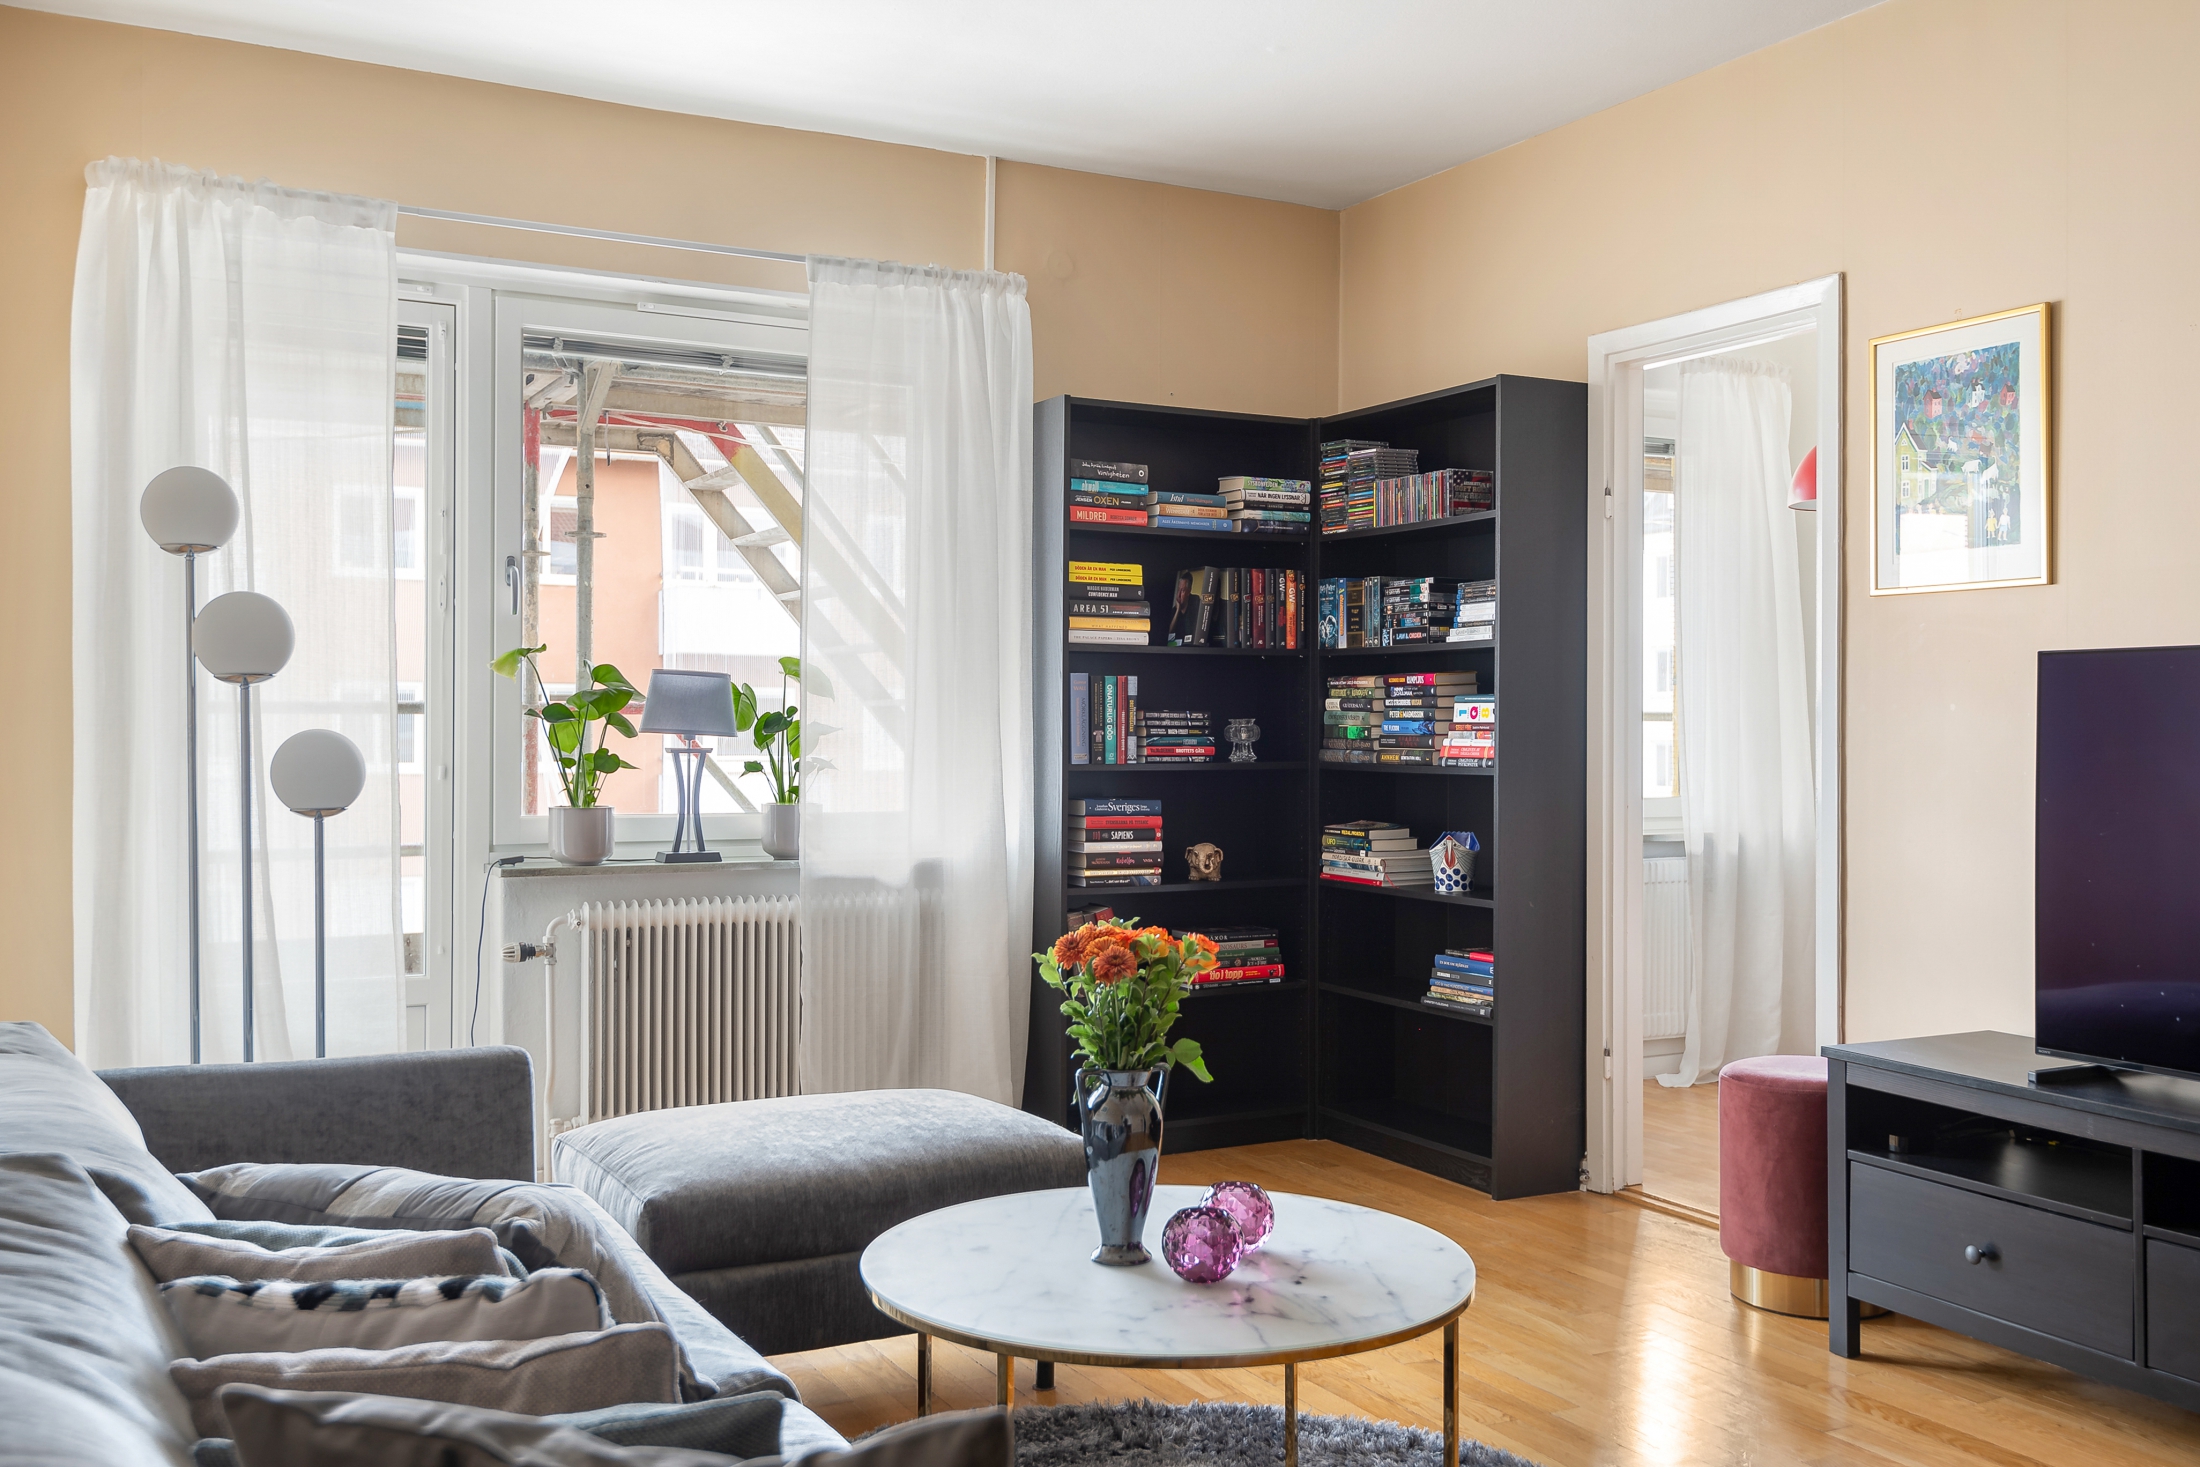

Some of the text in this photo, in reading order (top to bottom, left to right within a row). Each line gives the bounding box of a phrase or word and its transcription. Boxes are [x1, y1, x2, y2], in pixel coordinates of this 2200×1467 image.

[1094, 496, 1119, 505] OXEN
[1077, 510, 1106, 521] MILDRED
[1073, 604, 1096, 613] AREA
[1100, 605, 1109, 613] 51
[1108, 802, 1140, 814] Sveriges
[1111, 831, 1134, 839] SAPIENS
[1225, 970, 1243, 980] topp
